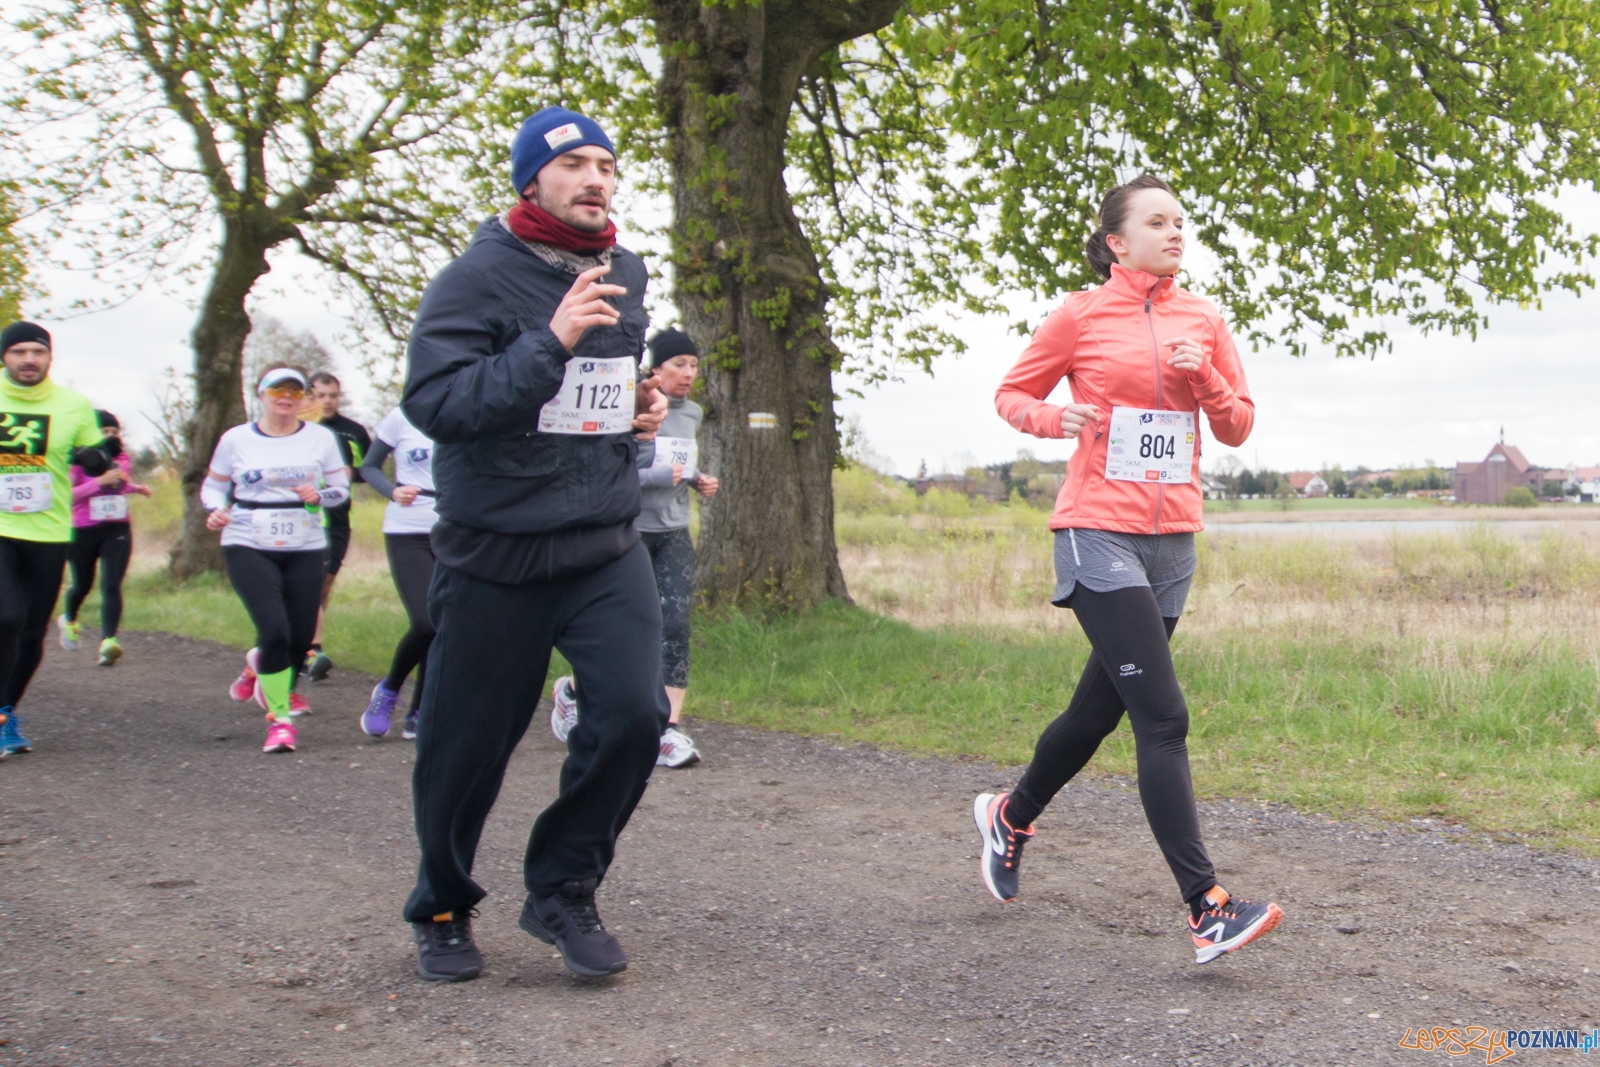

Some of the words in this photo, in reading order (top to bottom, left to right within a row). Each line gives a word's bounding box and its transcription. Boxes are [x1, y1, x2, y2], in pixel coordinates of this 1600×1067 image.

[575, 383, 621, 409] 1122
[1139, 433, 1175, 459] 804
[671, 451, 688, 466] 789
[6, 486, 33, 501] 763
[270, 522, 294, 535] 513
